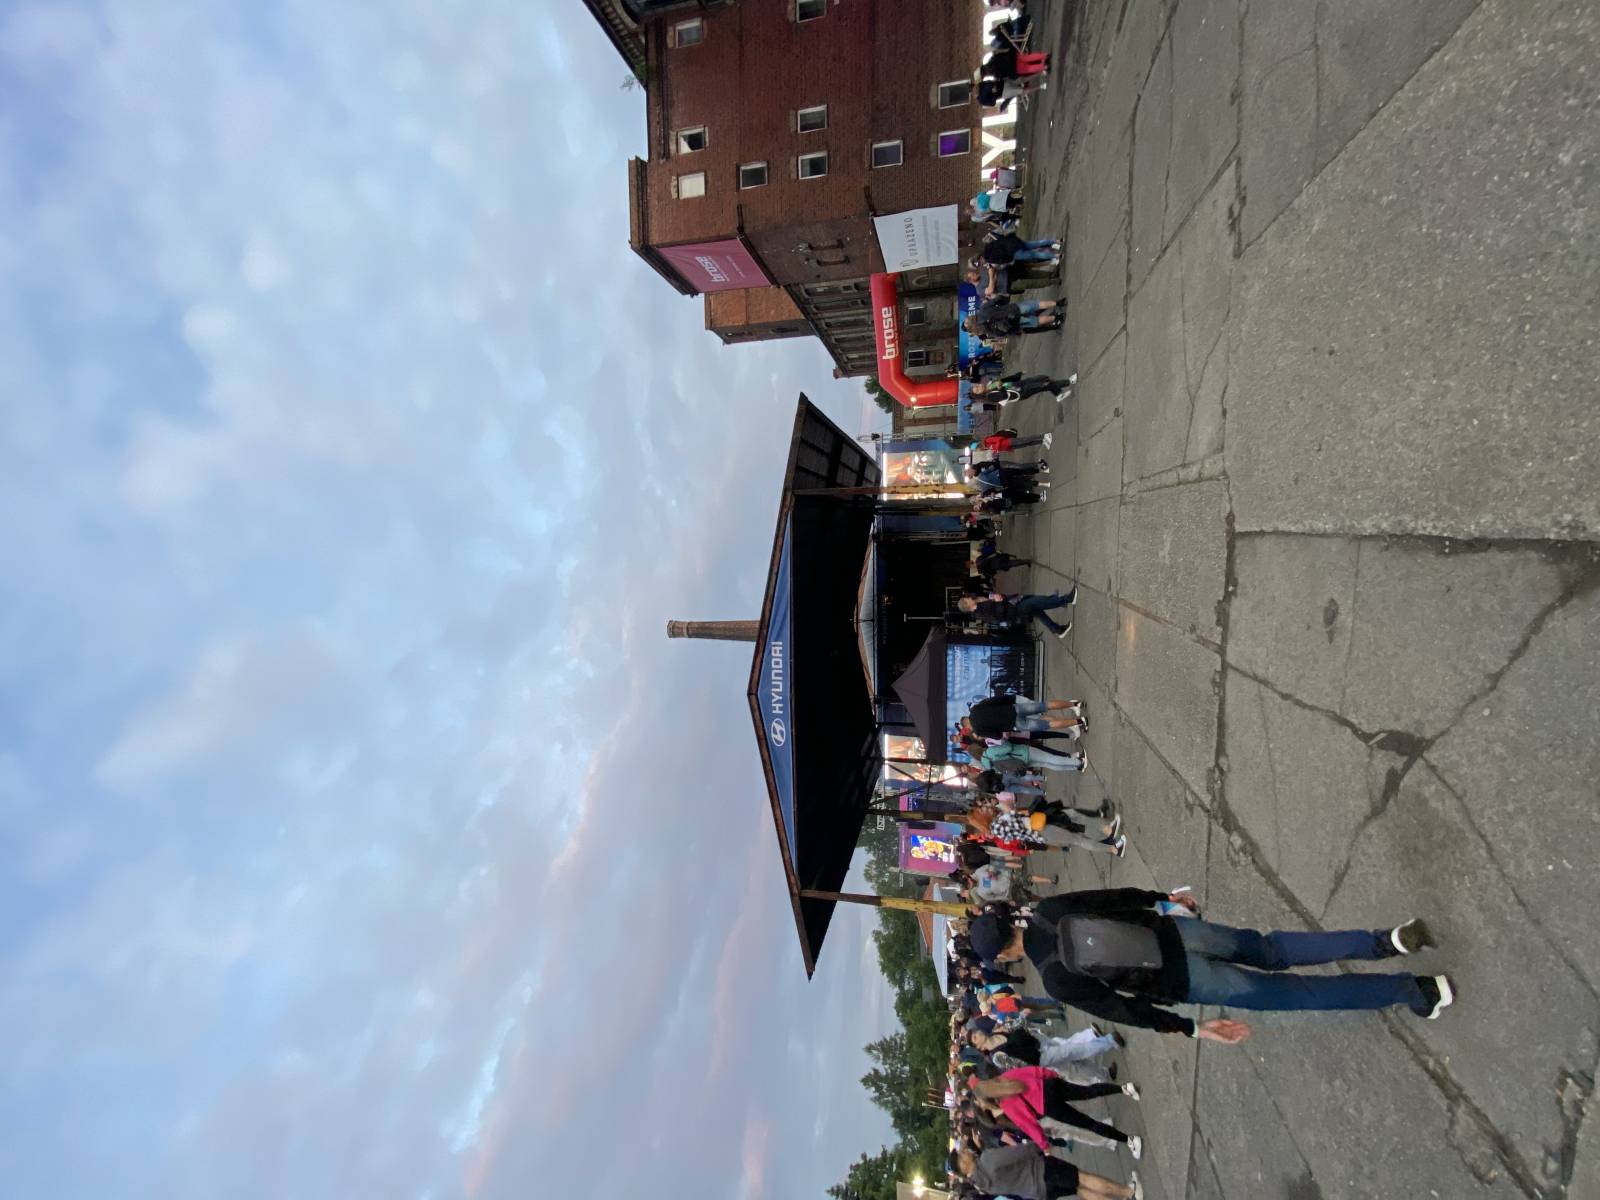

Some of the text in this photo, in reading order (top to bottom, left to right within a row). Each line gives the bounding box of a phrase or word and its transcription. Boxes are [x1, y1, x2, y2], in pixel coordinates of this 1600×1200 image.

[695, 256, 726, 282] brose
[881, 306, 896, 360] brose
[771, 641, 784, 714] HYUNDAI
